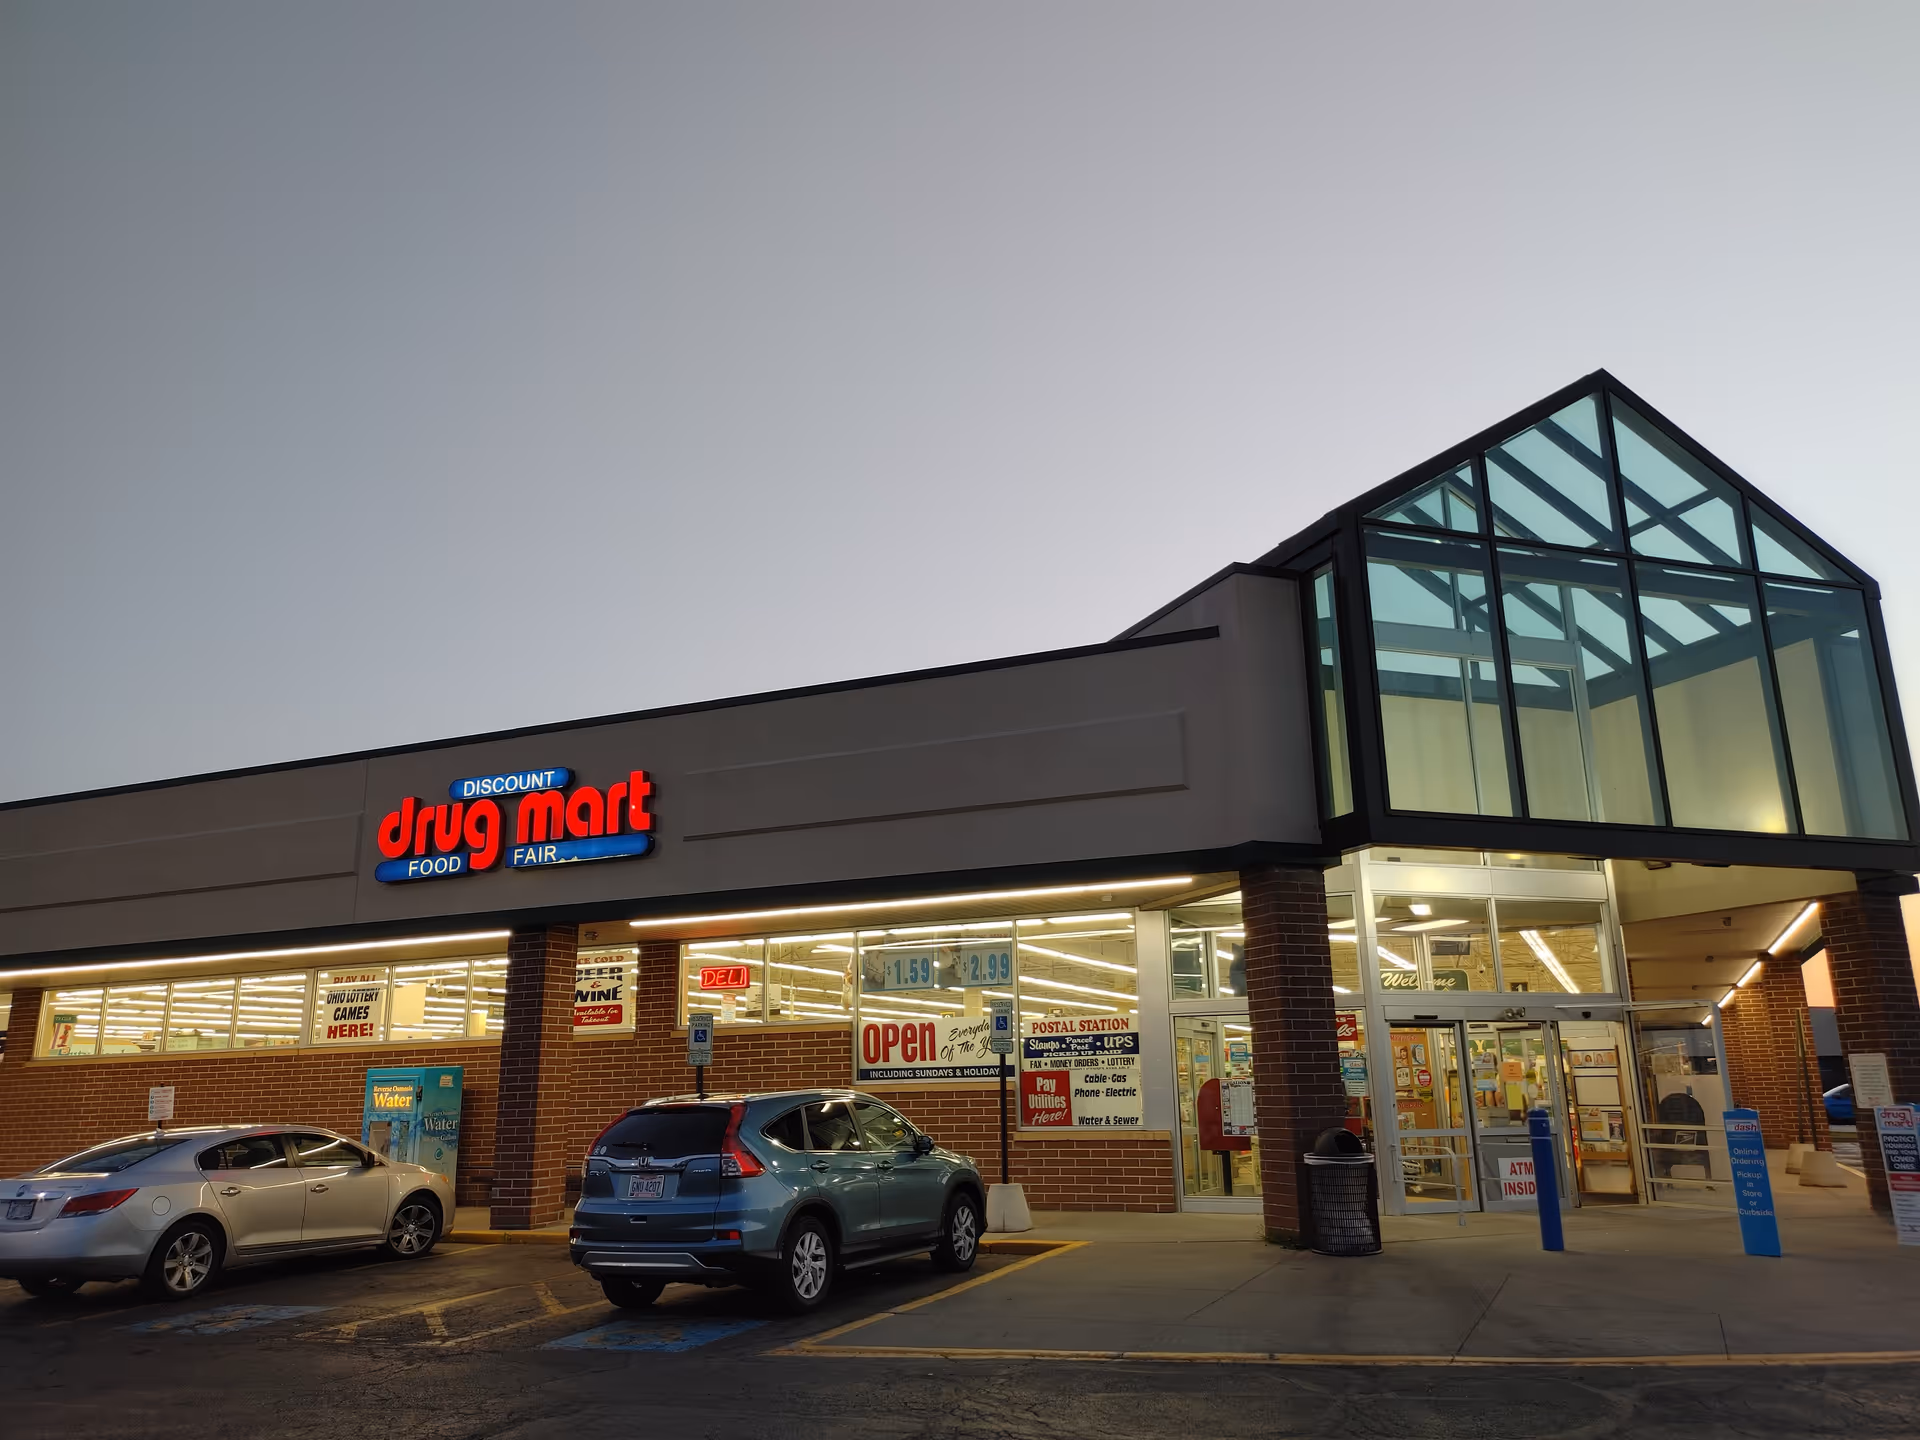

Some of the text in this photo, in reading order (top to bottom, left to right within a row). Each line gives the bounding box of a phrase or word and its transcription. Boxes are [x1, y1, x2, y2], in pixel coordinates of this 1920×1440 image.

[463, 770, 556, 797] DISCOUNT
[377, 769, 651, 871] drug mart
[513, 845, 557, 865] FAIR
[408, 856, 462, 877] FOOD
[576, 955, 625, 965] CE COLD
[702, 968, 744, 986] DELI
[1381, 971, 1456, 987] Welme
[326, 988, 380, 1005] OHIO LOTTERY
[333, 1005, 370, 1021] GAMES
[327, 1023, 374, 1039] HERE!
[948, 1018, 991, 1042] Everyda
[1031, 1018, 1130, 1034] POSTAL STATION
[1029, 1038, 1060, 1052] Stamps
[1065, 1035, 1094, 1044] Parcel
[1103, 1035, 1135, 1048] UPS
[940, 1043, 956, 1063] Of
[957, 1040, 975, 1055] The
[1029, 1060, 1042, 1069] FAX
[1049, 1059, 1072, 1068] MONEY
[1073, 1058, 1099, 1067] ORDERS
[1106, 1057, 1136, 1066] LOTTERY
[869, 1067, 1000, 1078] INCLUDING SUNDAYS & HOLIDAY
[1084, 1073, 1127, 1083] Cable Gas
[1035, 1076, 1056, 1093] Pay
[1074, 1086, 1137, 1097] Phone Electric
[373, 1092, 413, 1108] Water
[1028, 1093, 1067, 1109] Utilities
[1078, 1115, 1139, 1125] Water & Sewer
[1880, 1108, 1906, 1121] drug
[424, 1117, 458, 1131] Water
[1734, 1123, 1758, 1132] dash
[1733, 1147, 1759, 1155] Online
[1509, 1161, 1534, 1176] ATM
[1731, 1157, 1764, 1167] Ordering
[1736, 1171, 1762, 1179] Pickup
[1503, 1181, 1536, 1196] INSID
[1742, 1189, 1763, 1198] Store
